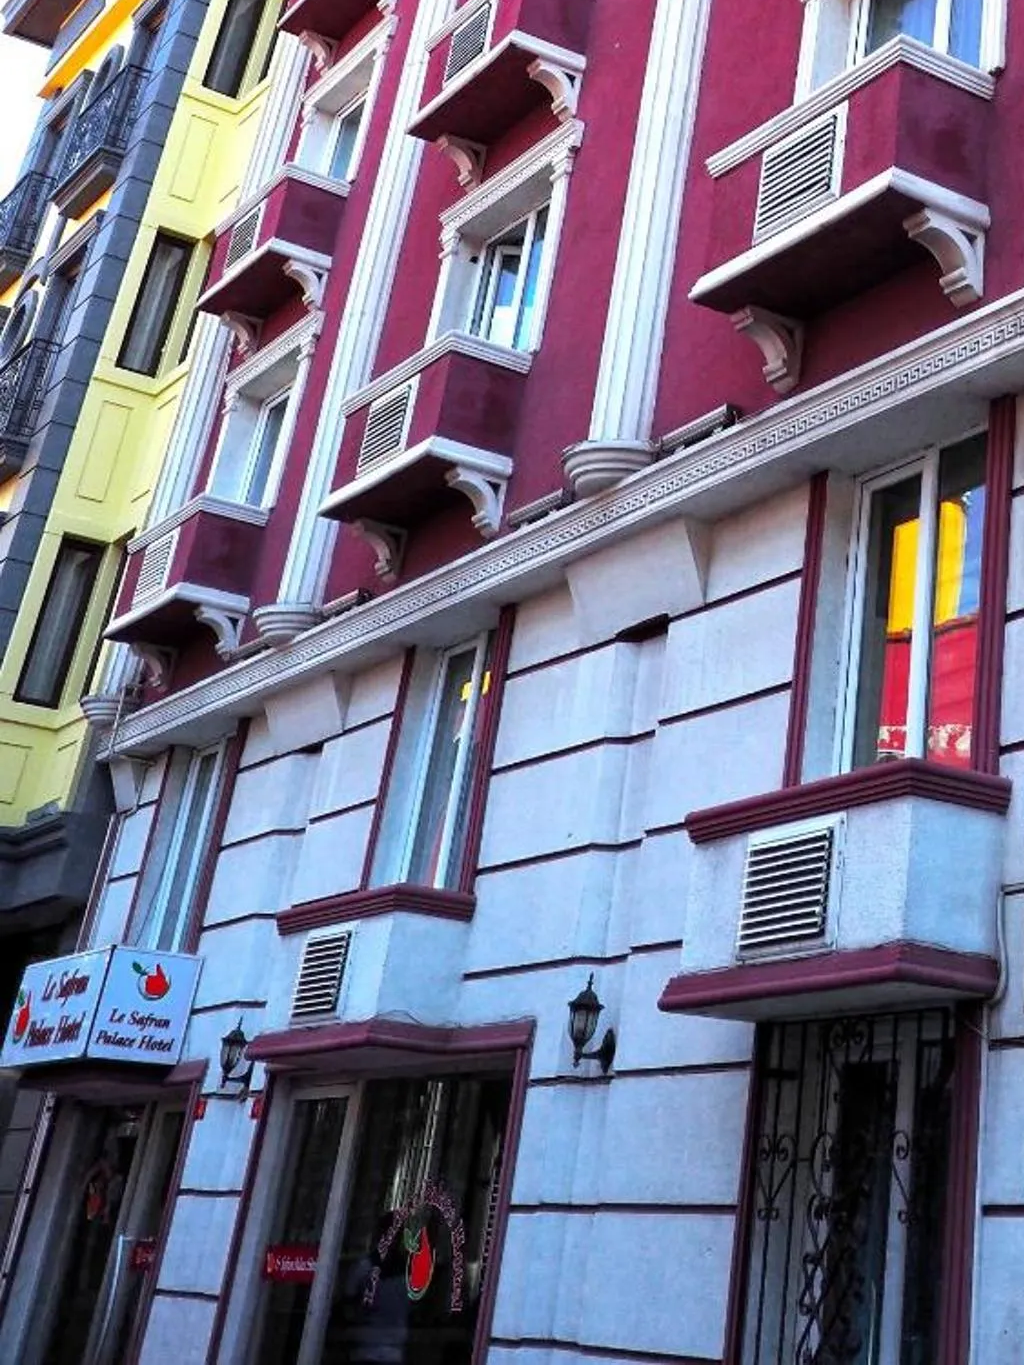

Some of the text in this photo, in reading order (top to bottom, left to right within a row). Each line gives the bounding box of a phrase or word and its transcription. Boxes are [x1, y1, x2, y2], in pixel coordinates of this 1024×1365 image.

[108, 1008, 171, 1033] Le Safran
[95, 1029, 175, 1053] Palace Hotel
